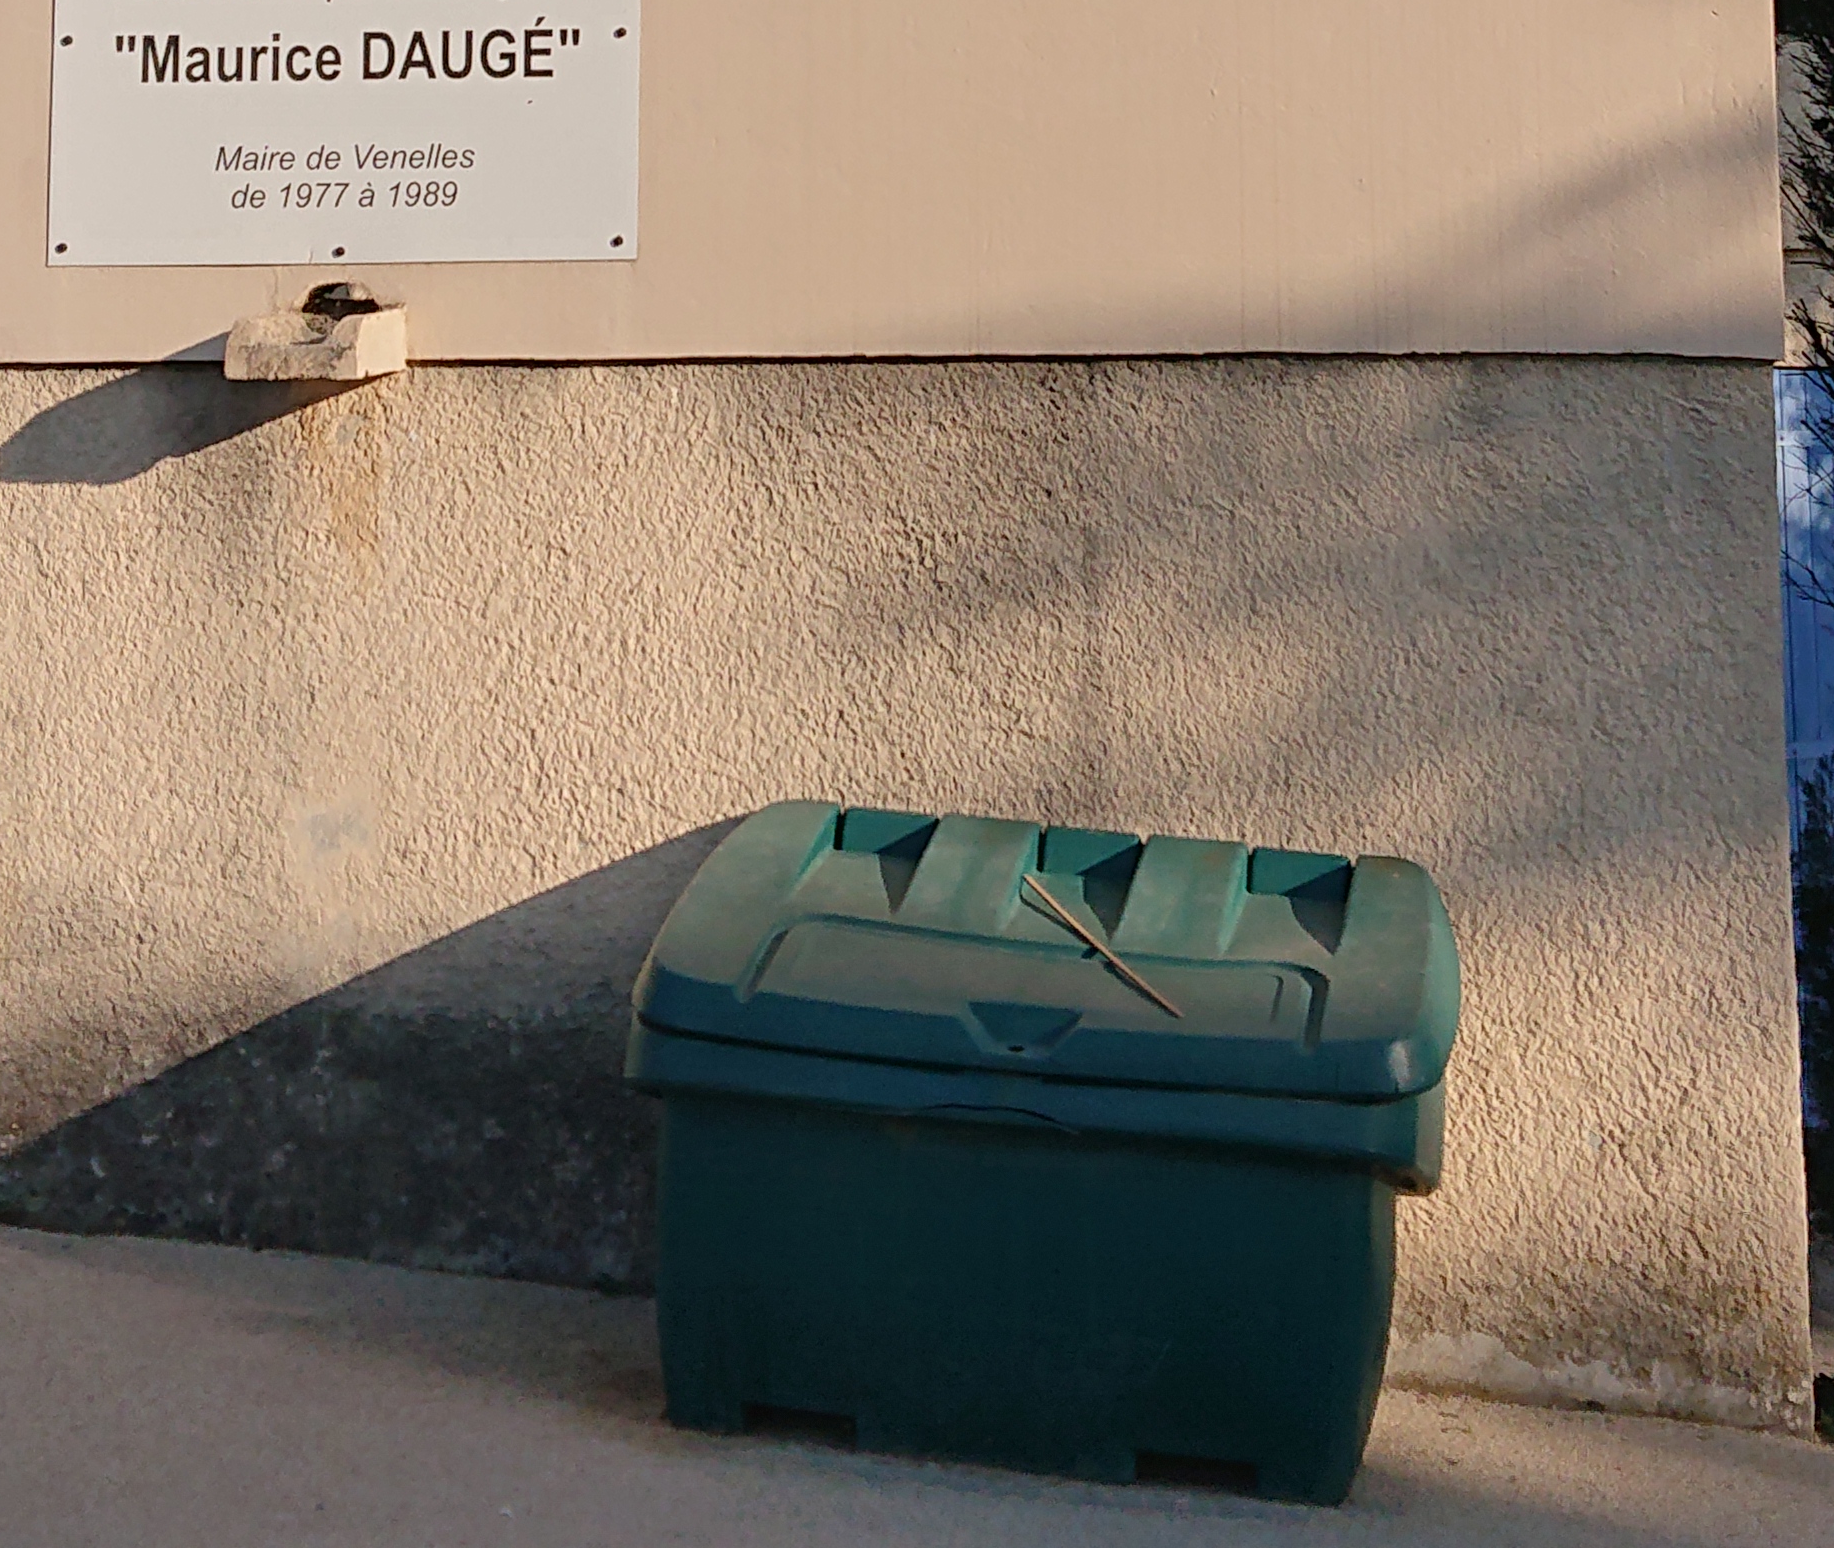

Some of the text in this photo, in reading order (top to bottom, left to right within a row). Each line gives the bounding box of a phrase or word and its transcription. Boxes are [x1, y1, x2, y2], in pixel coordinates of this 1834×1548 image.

[114, 17, 581, 83] "Maurice DAUGÉ"
[215, 143, 476, 172] Maire de Venelles
[231, 180, 458, 209] de 1977 à 1989
